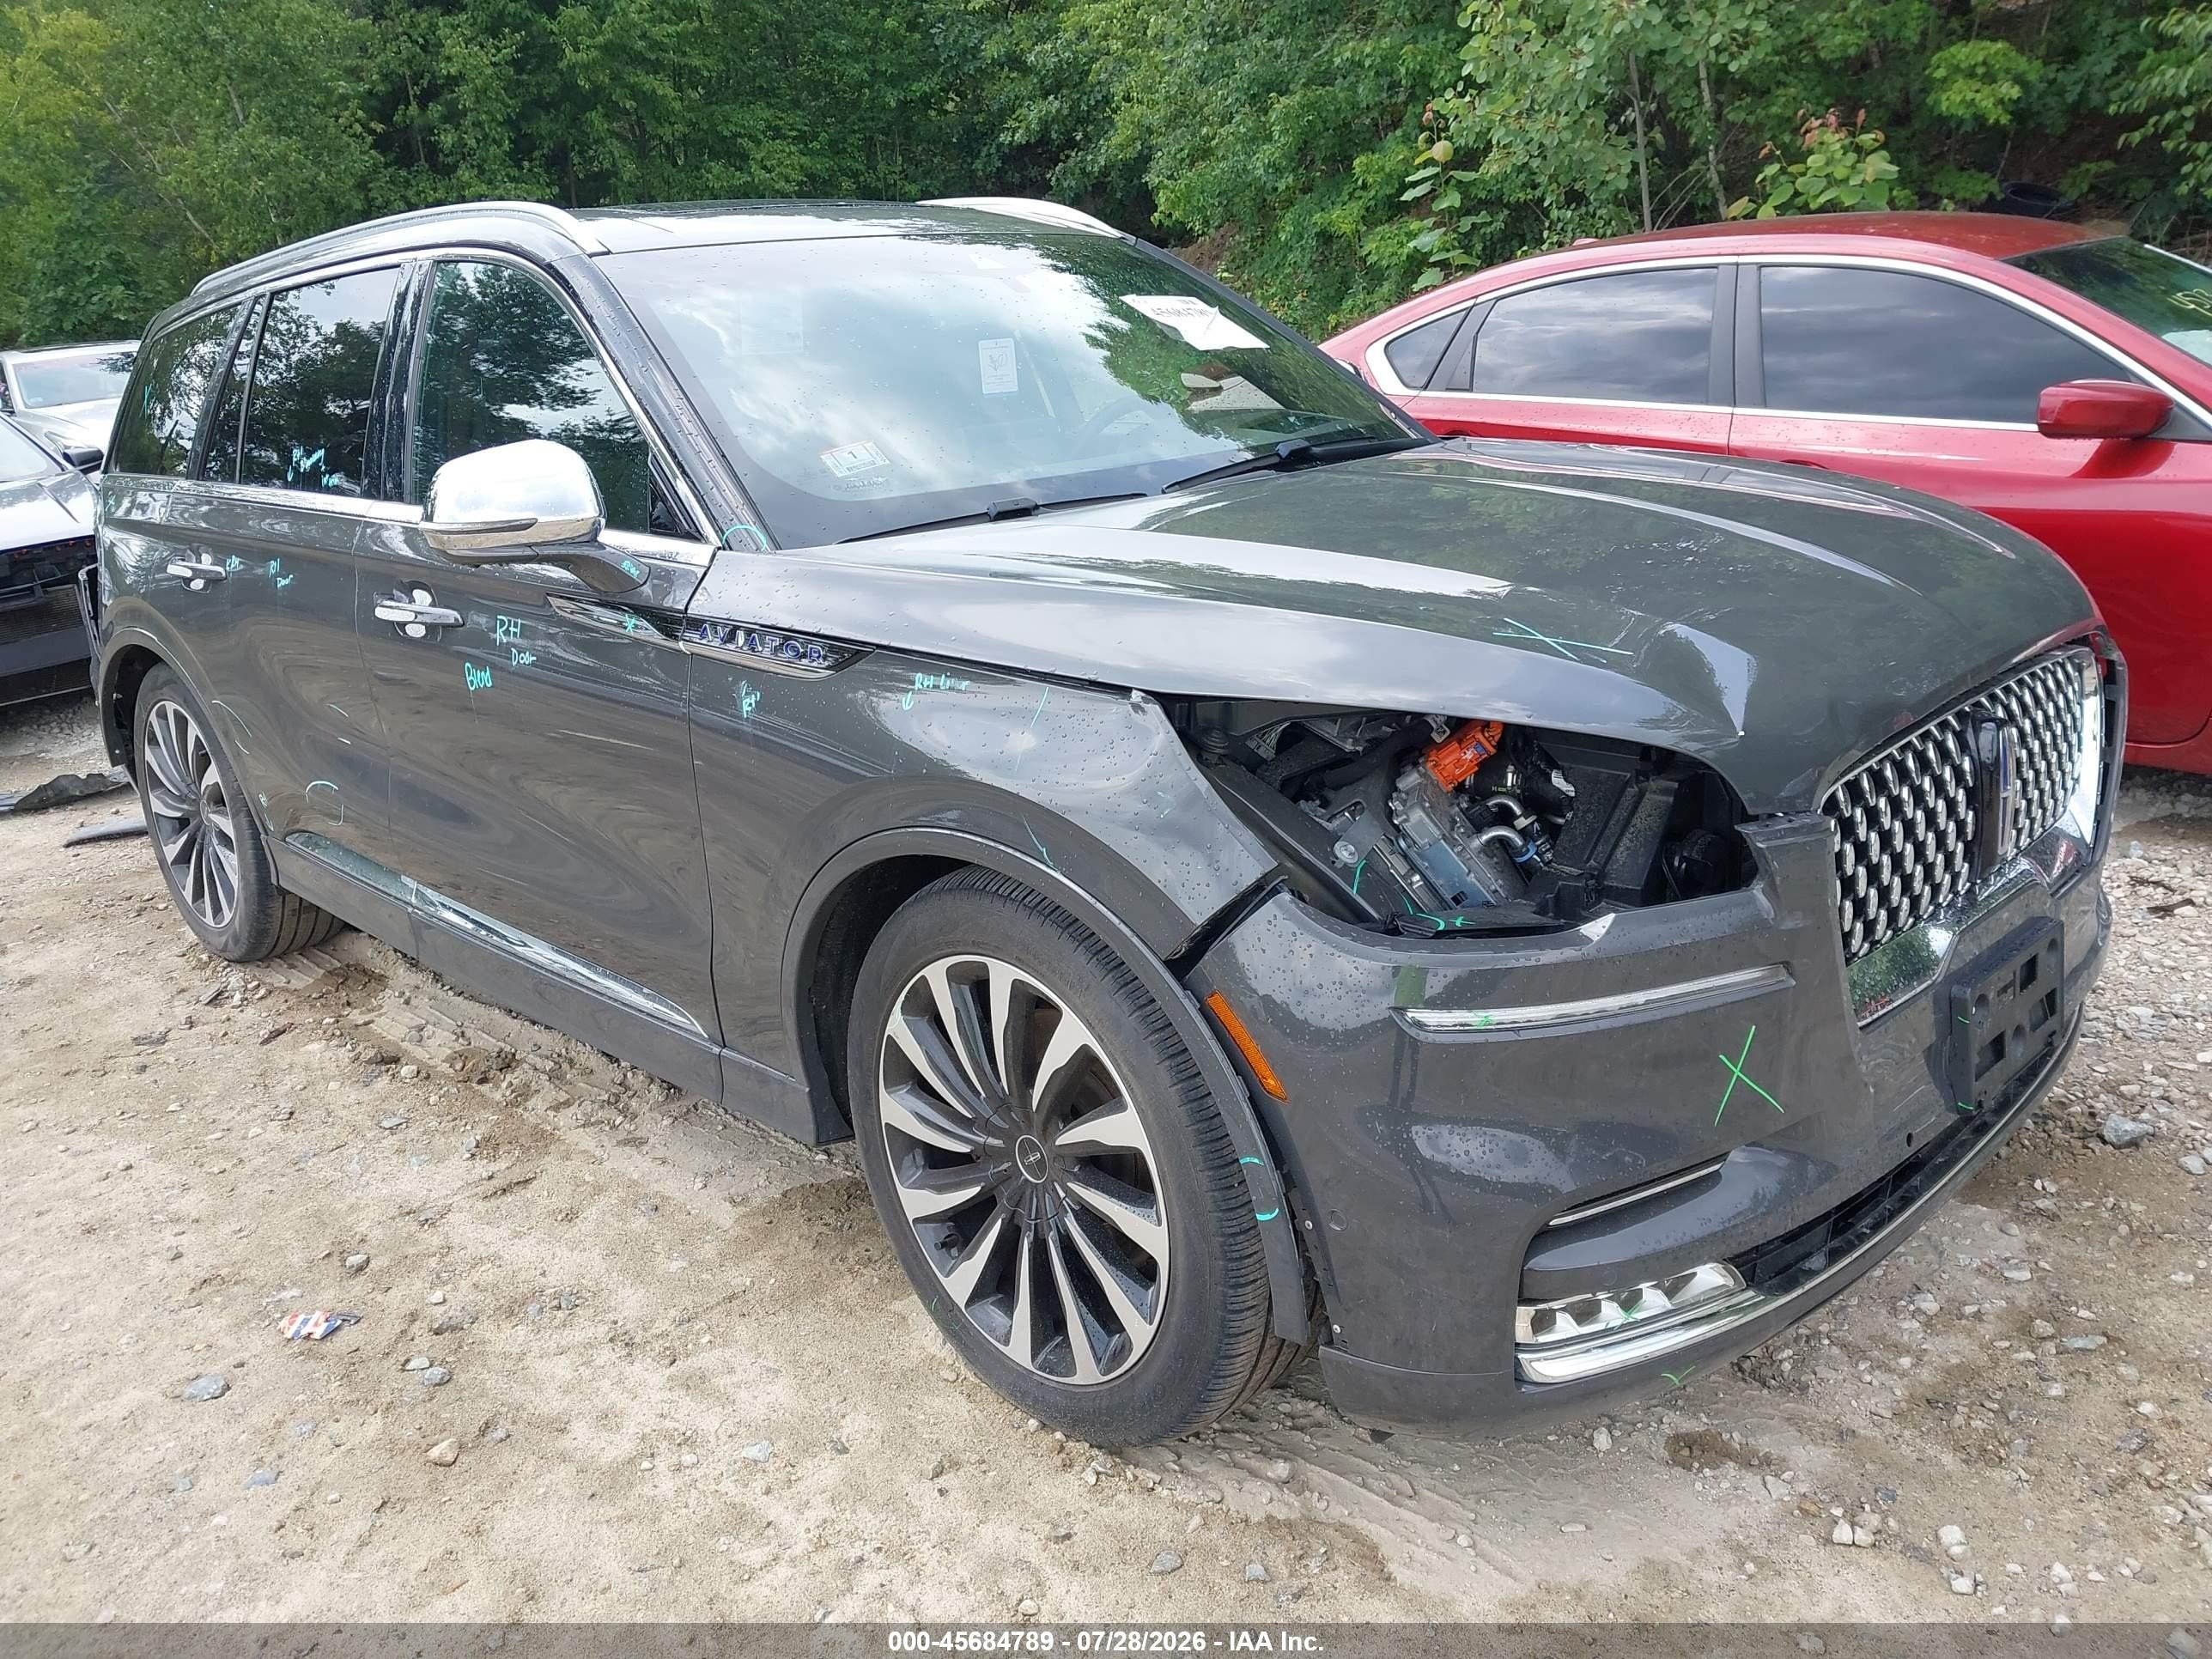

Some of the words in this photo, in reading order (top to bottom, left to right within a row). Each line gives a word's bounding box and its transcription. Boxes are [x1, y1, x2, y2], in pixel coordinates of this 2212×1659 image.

[496, 615, 520, 647] RH
[700, 623, 824, 665] AVIATOR
[511, 647, 537, 666] Door
